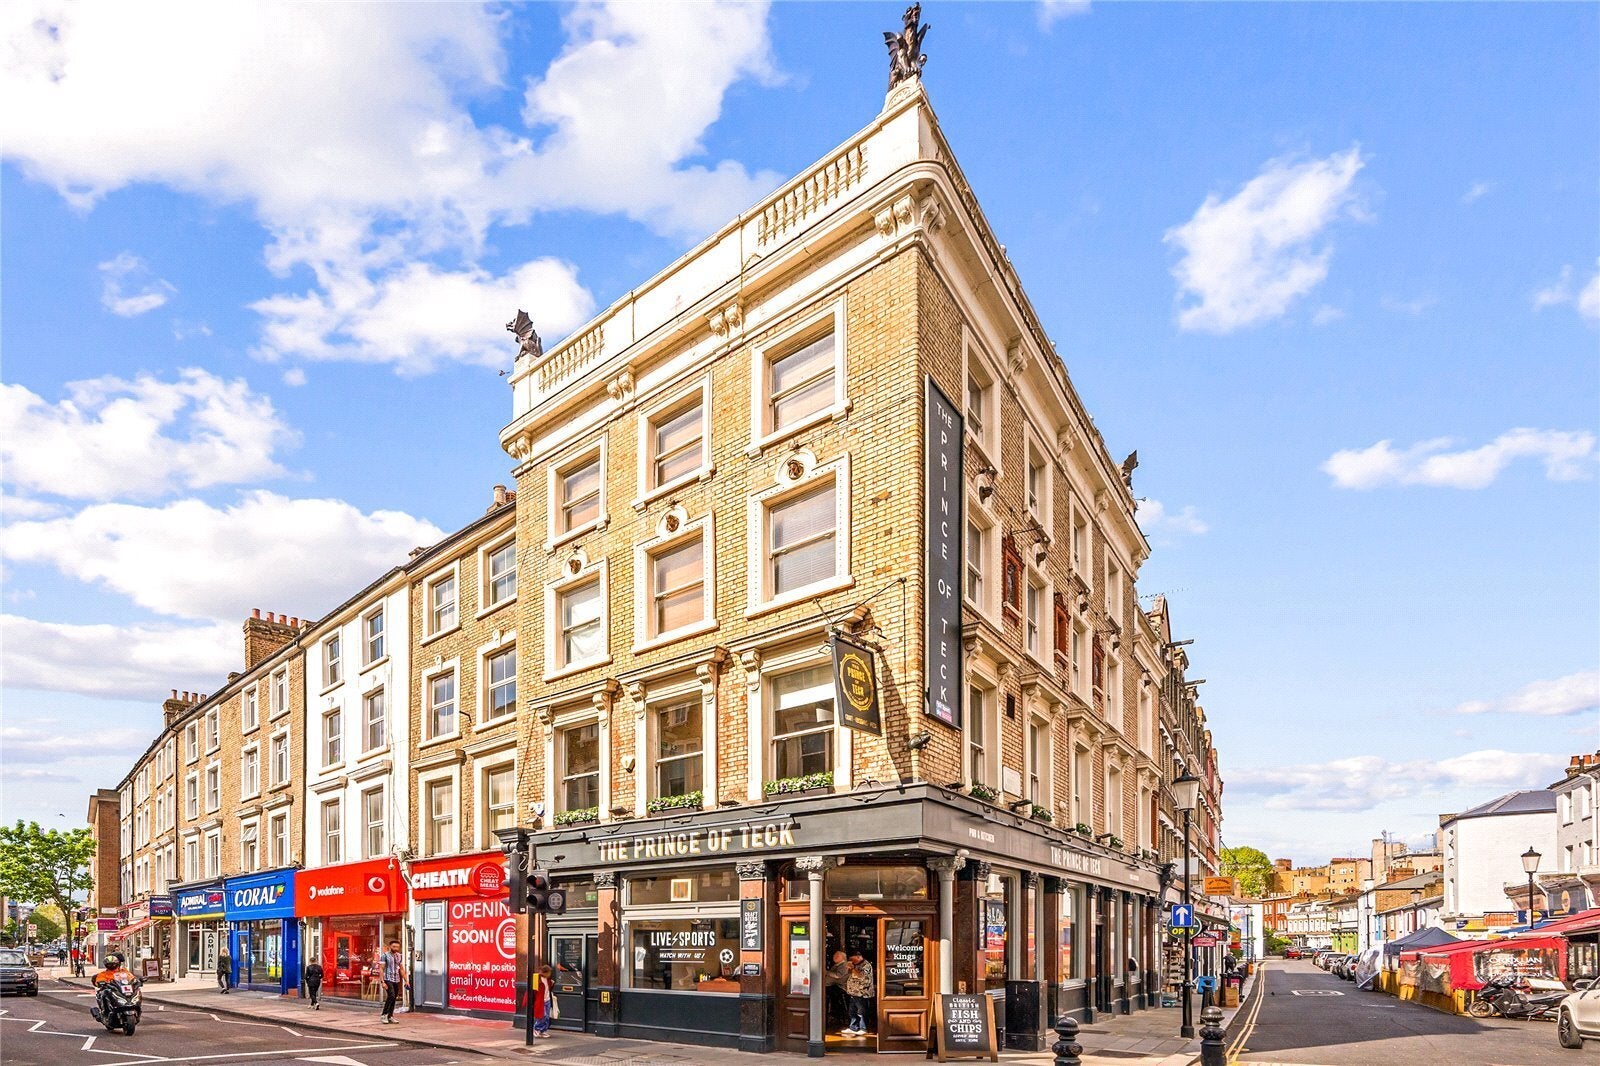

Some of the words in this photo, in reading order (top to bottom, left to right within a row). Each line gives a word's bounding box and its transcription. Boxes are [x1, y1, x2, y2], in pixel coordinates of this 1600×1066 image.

[936, 402, 952, 430] THE
[938, 579, 952, 599] OF
[940, 617, 948, 702] TECK
[598, 839, 629, 862] THE
[633, 831, 701, 859] PRINCE
[706, 828, 733, 851] OF
[738, 821, 795, 849] TECK
[1050, 846, 1062, 866] THE
[1062, 849, 1082, 872] PRINCE
[1082, 855, 1089, 873] OF
[1089, 857, 1101, 875] TECK
[234, 885, 277, 908] CORAL
[317, 886, 345, 898] vodafone
[181, 893, 208, 908] ADMIRAL
[451, 901, 511, 920] OPENIN
[452, 929, 494, 944] SOON!
[650, 931, 673, 947] LIVE
[679, 931, 716, 947] SPORTS
[207, 932, 215, 969] ADMIRAL
[893, 953, 916, 961] Kings
[449, 960, 481, 973] Recruiting
[482, 961, 490, 971] all
[491, 961, 516, 973] positio
[890, 967, 920, 975] Queens
[450, 973, 473, 985] email
[475, 977, 496, 990] your
[498, 978, 509, 988] cv
[510, 977, 516, 988] t
[951, 1009, 979, 1019] FISH
[949, 1024, 982, 1033] CHIPS
